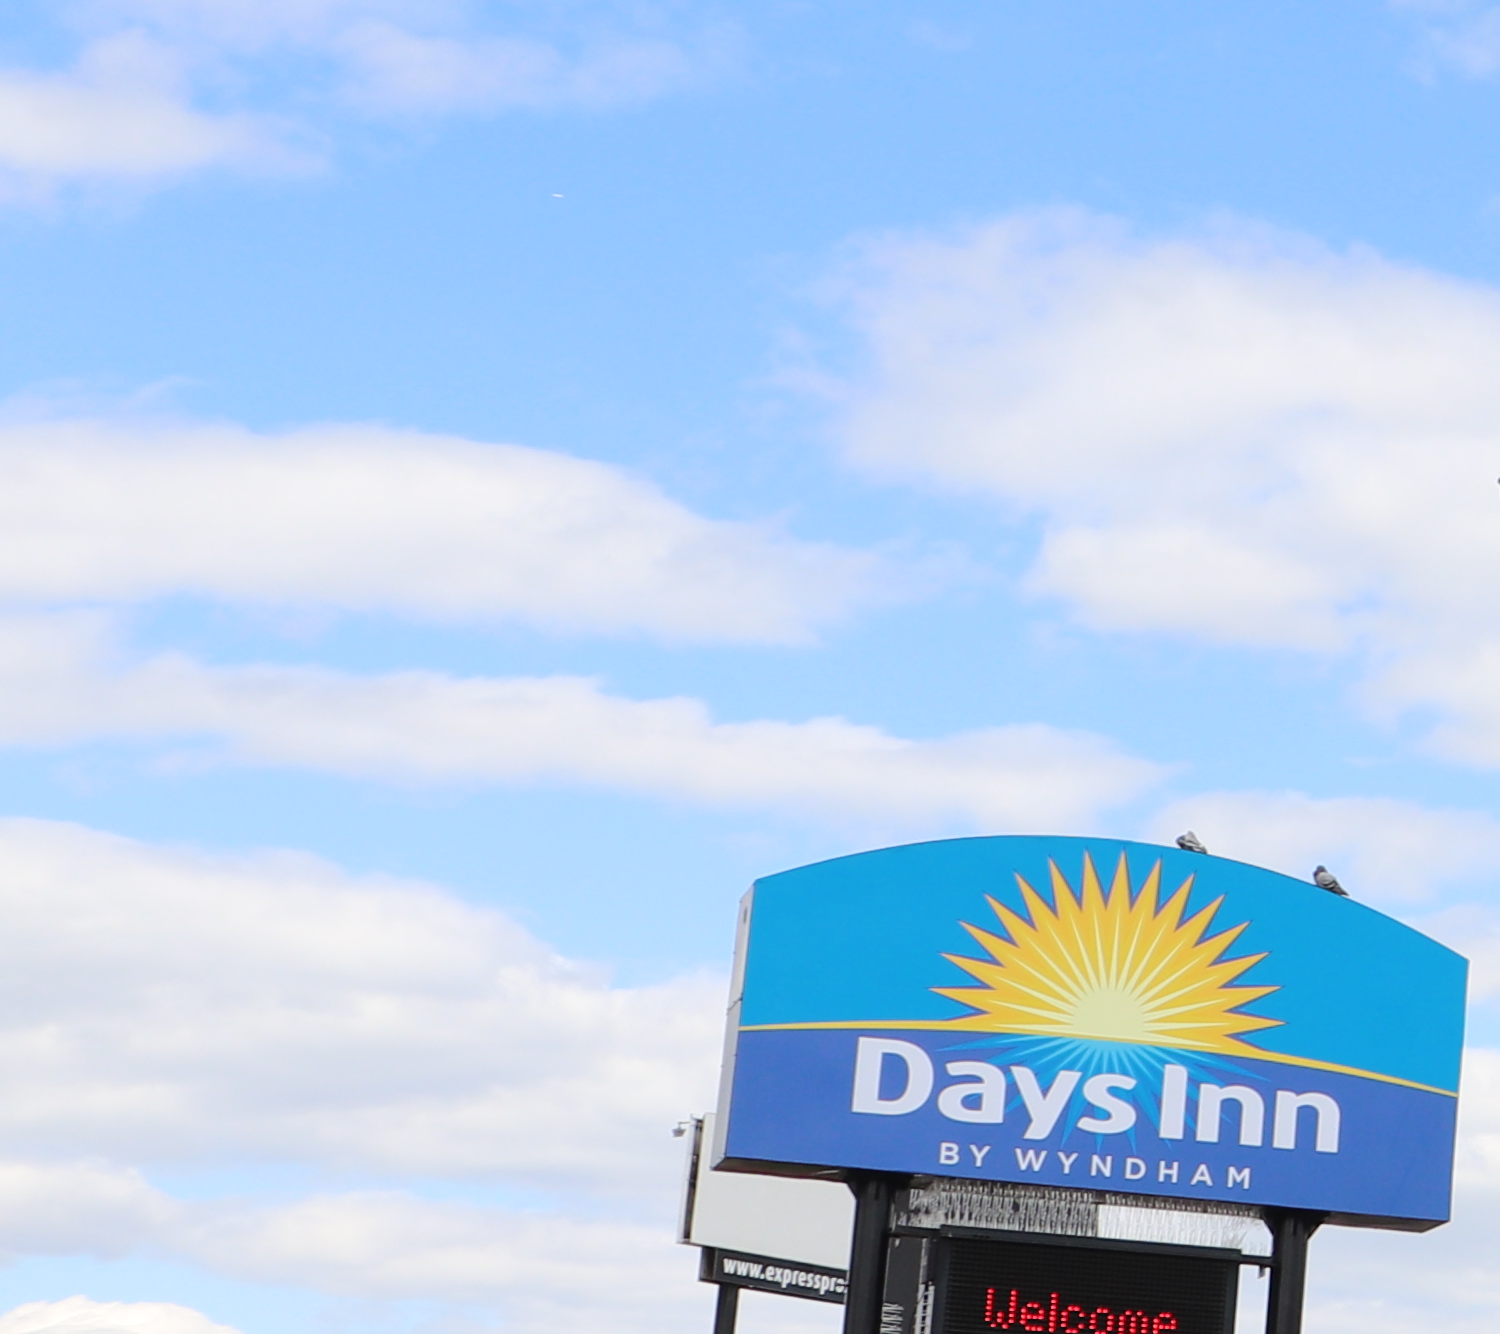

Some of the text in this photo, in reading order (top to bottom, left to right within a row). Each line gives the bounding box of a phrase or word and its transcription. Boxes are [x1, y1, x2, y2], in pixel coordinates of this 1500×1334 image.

[851, 1036, 1341, 1153] Days Inn
[939, 1142, 1252, 1190] BY WYNDHAM
[723, 1257, 848, 1295] www.expresspro
